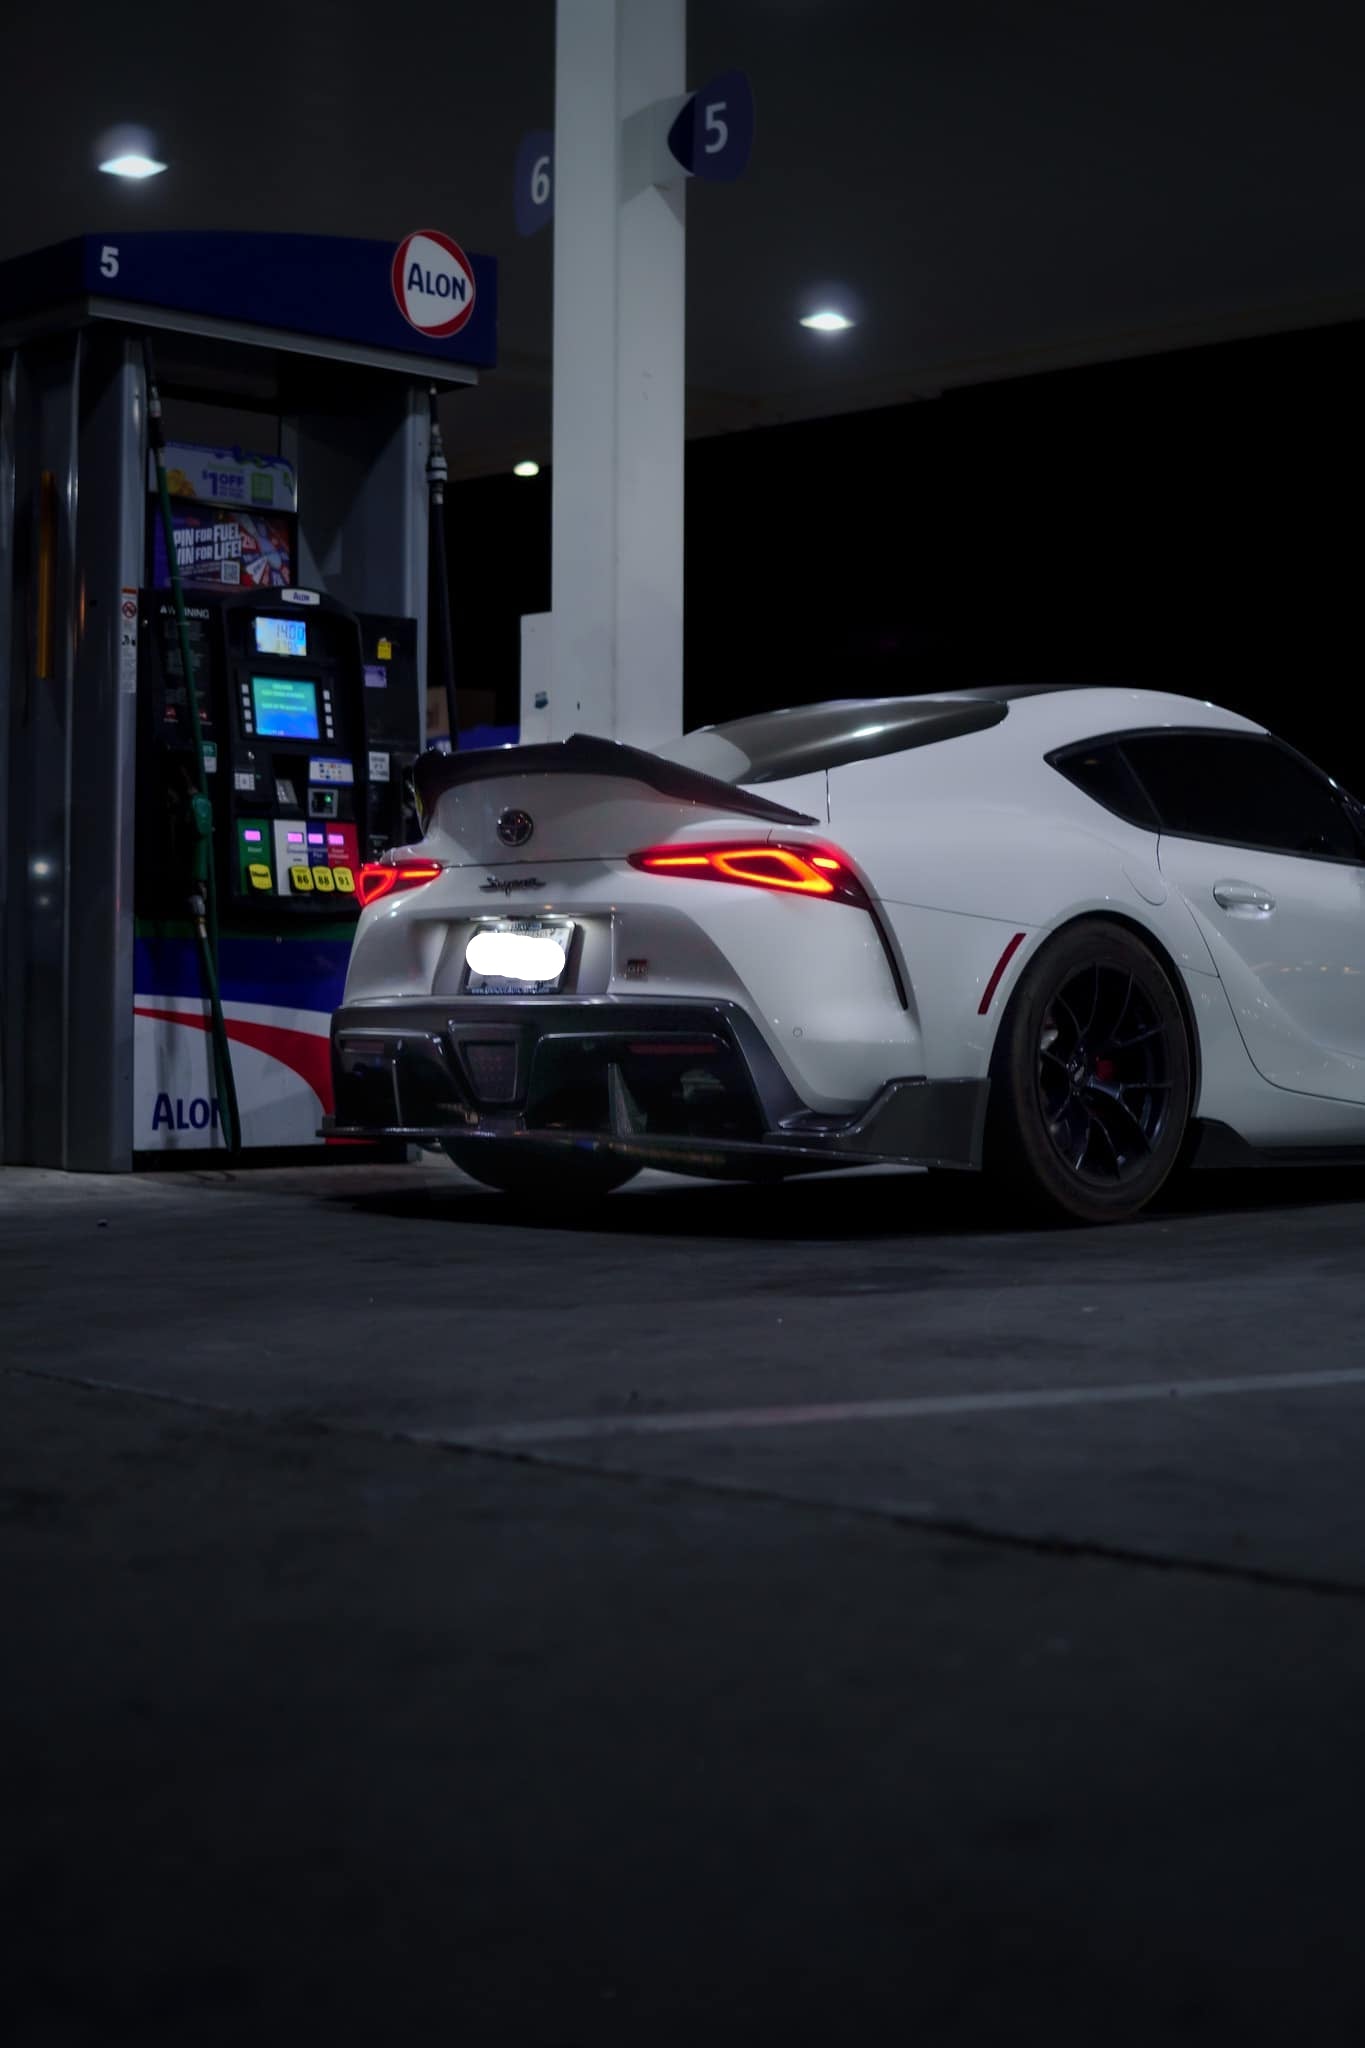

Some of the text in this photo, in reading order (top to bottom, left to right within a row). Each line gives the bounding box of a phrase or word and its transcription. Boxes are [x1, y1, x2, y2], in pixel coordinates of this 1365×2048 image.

[705, 101, 729, 154] 5
[531, 155, 550, 205] 6
[99, 245, 120, 279] 5
[408, 263, 466, 302] ALON
[219, 471, 244, 487] OFF
[172, 528, 195, 548] PIN
[195, 527, 213, 544] FOR
[214, 522, 240, 542] FUEL
[195, 545, 213, 561] FOR
[214, 539, 241, 560] LIFE!
